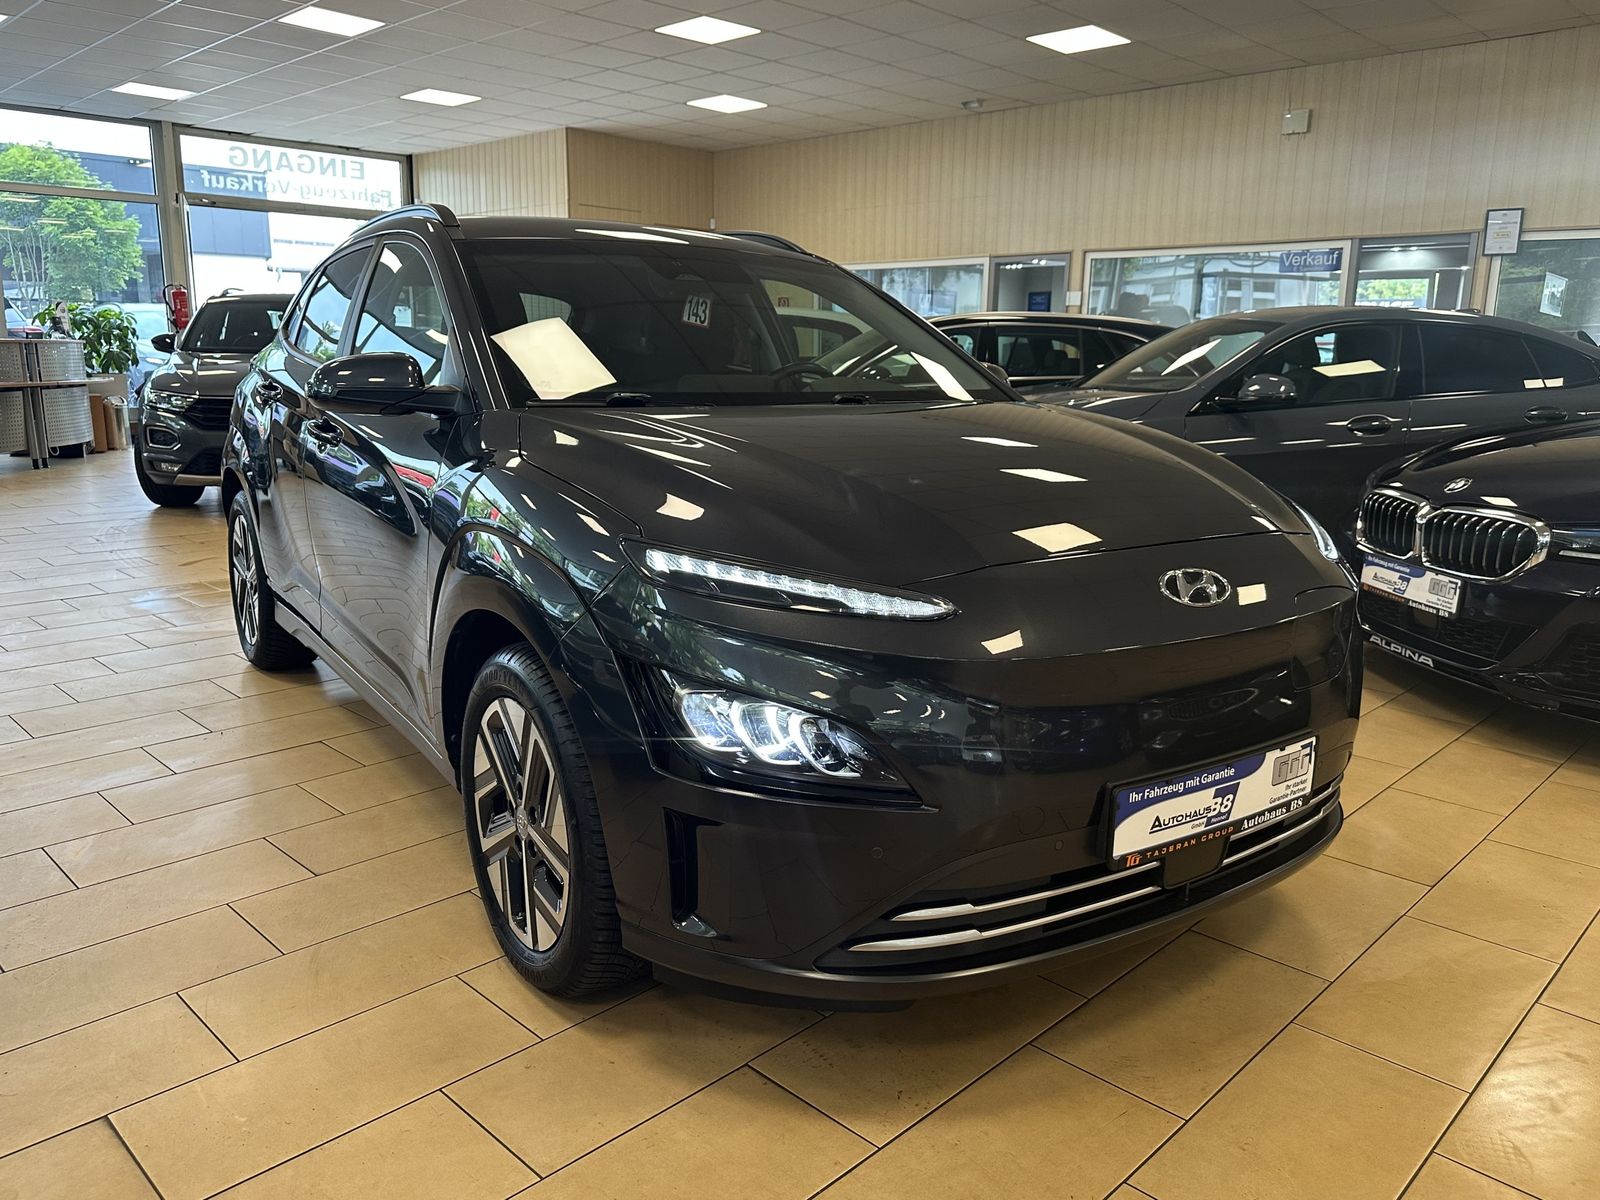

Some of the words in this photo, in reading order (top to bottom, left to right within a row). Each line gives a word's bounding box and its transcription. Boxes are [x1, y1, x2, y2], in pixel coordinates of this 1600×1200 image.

[1282, 251, 1339, 266] Verkauf
[687, 298, 708, 324] 143
[1408, 599, 1437, 614] Autohaus
[1369, 635, 1434, 668] ALPINA
[1129, 792, 1143, 803] Ihr
[1144, 783, 1184, 800] Fahrzeug
[1185, 777, 1200, 788] mit
[1201, 767, 1235, 783] Garantie
[1269, 786, 1307, 804] Garantie-Partner
[1241, 806, 1287, 831] Autohaus
[1146, 838, 1196, 858] TAJERAN
[1201, 826, 1234, 841] GROUP
